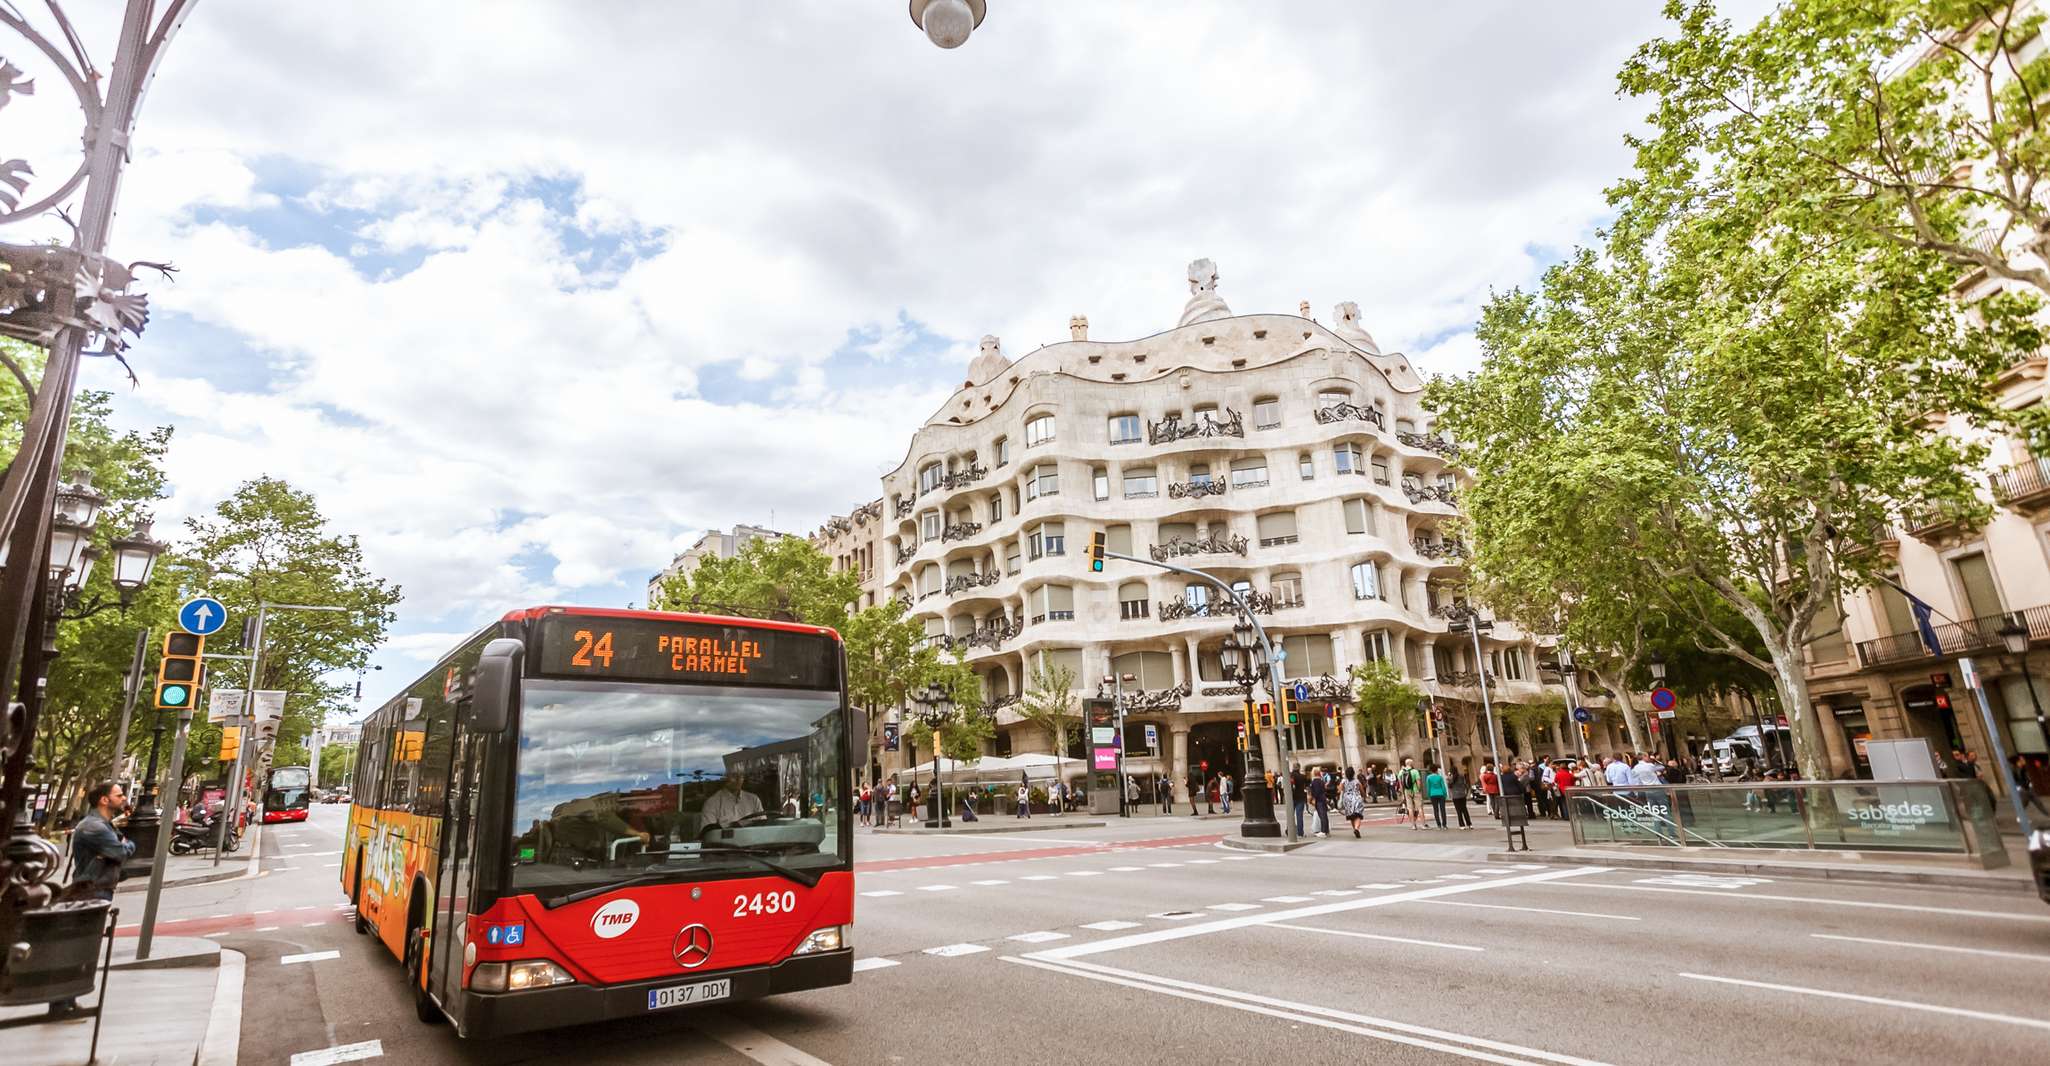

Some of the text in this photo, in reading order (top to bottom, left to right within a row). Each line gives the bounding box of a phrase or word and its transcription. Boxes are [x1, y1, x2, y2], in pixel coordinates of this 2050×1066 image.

[571, 630, 615, 667] 24
[671, 654, 748, 674] CARMEL
[733, 890, 796, 918] 2430
[602, 912, 633, 926] TMB
[659, 981, 727, 1006] 0137 DDY
